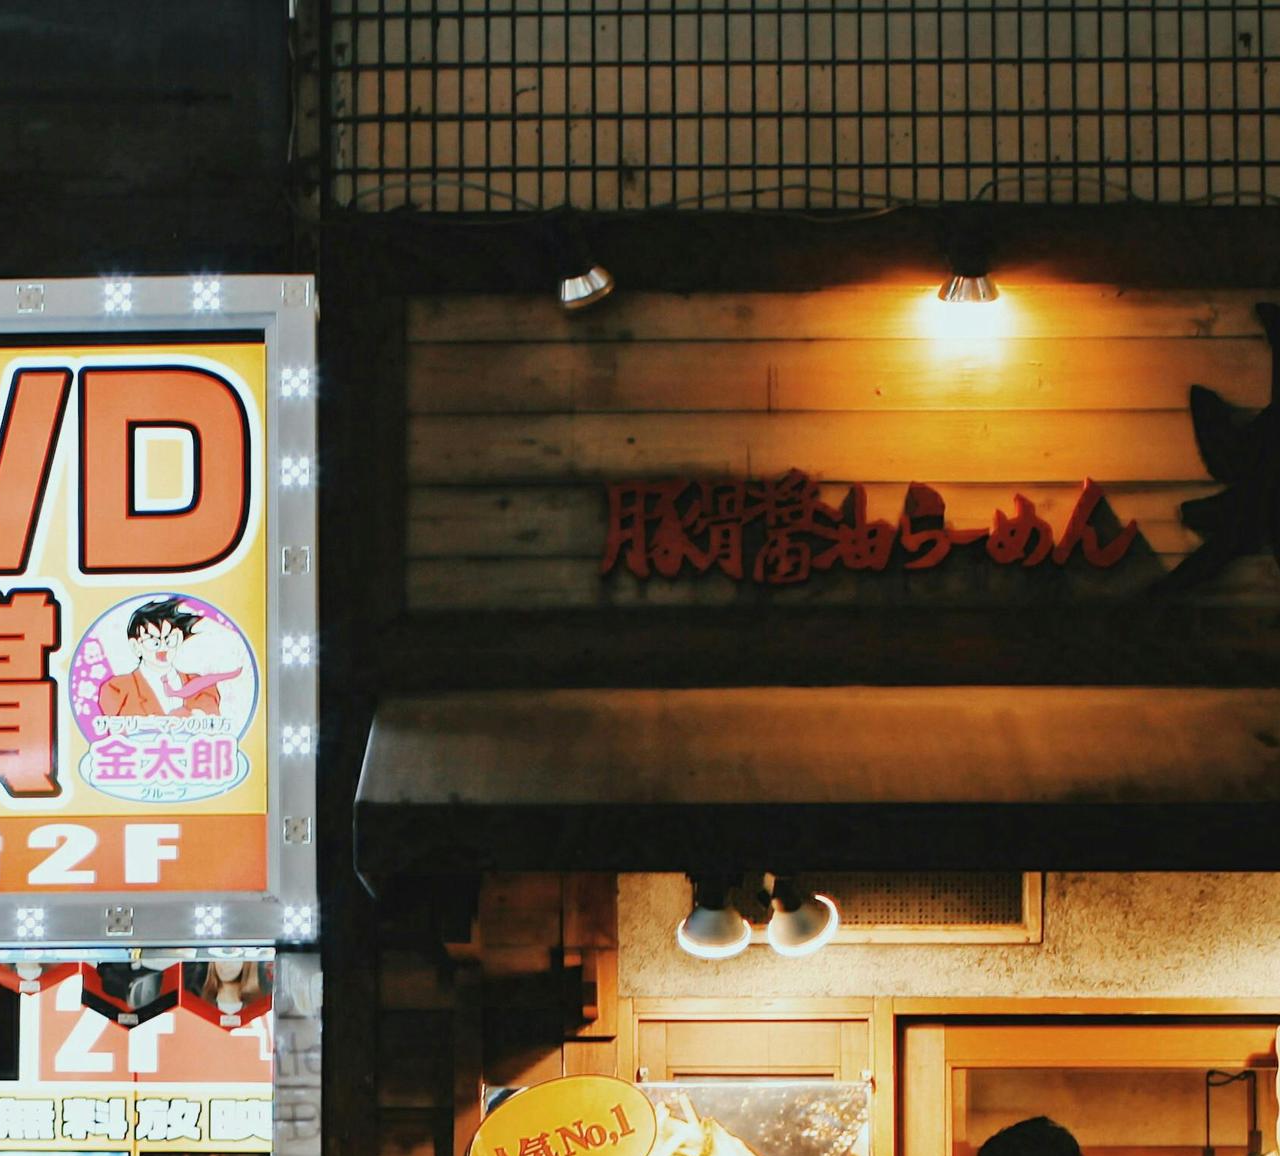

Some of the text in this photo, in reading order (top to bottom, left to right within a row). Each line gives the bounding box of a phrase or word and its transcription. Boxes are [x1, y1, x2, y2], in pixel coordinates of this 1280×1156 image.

[601, 467, 1138, 586] 豚骨醤油らーめん
[95, 739, 233, 780] 金太郎
